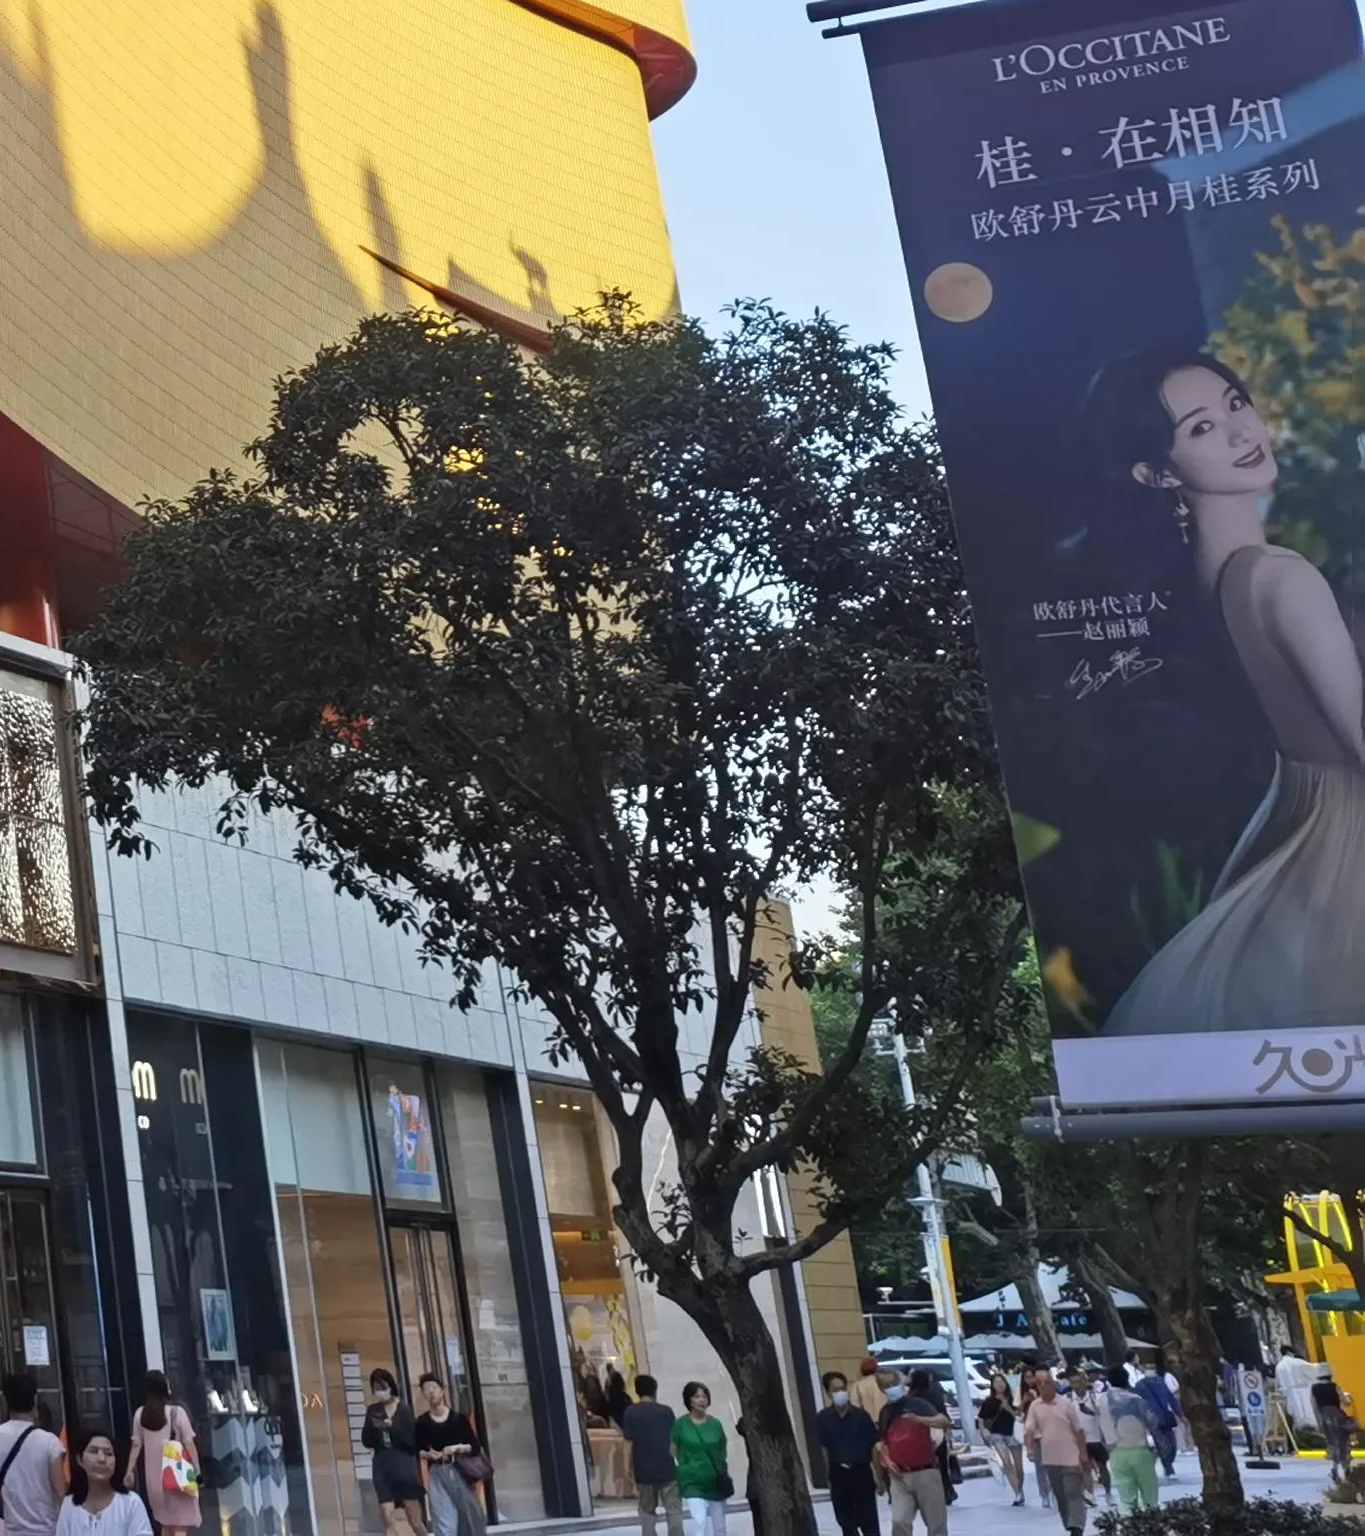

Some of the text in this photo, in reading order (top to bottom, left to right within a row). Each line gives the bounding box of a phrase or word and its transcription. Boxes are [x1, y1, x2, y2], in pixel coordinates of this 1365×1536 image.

[1040, 56, 1190, 94] EN PROVENCE
[970, 159, 1320, 242] 欧舒丹云中月桂系列
[1033, 592, 1168, 621] 欧舒丹代言人
